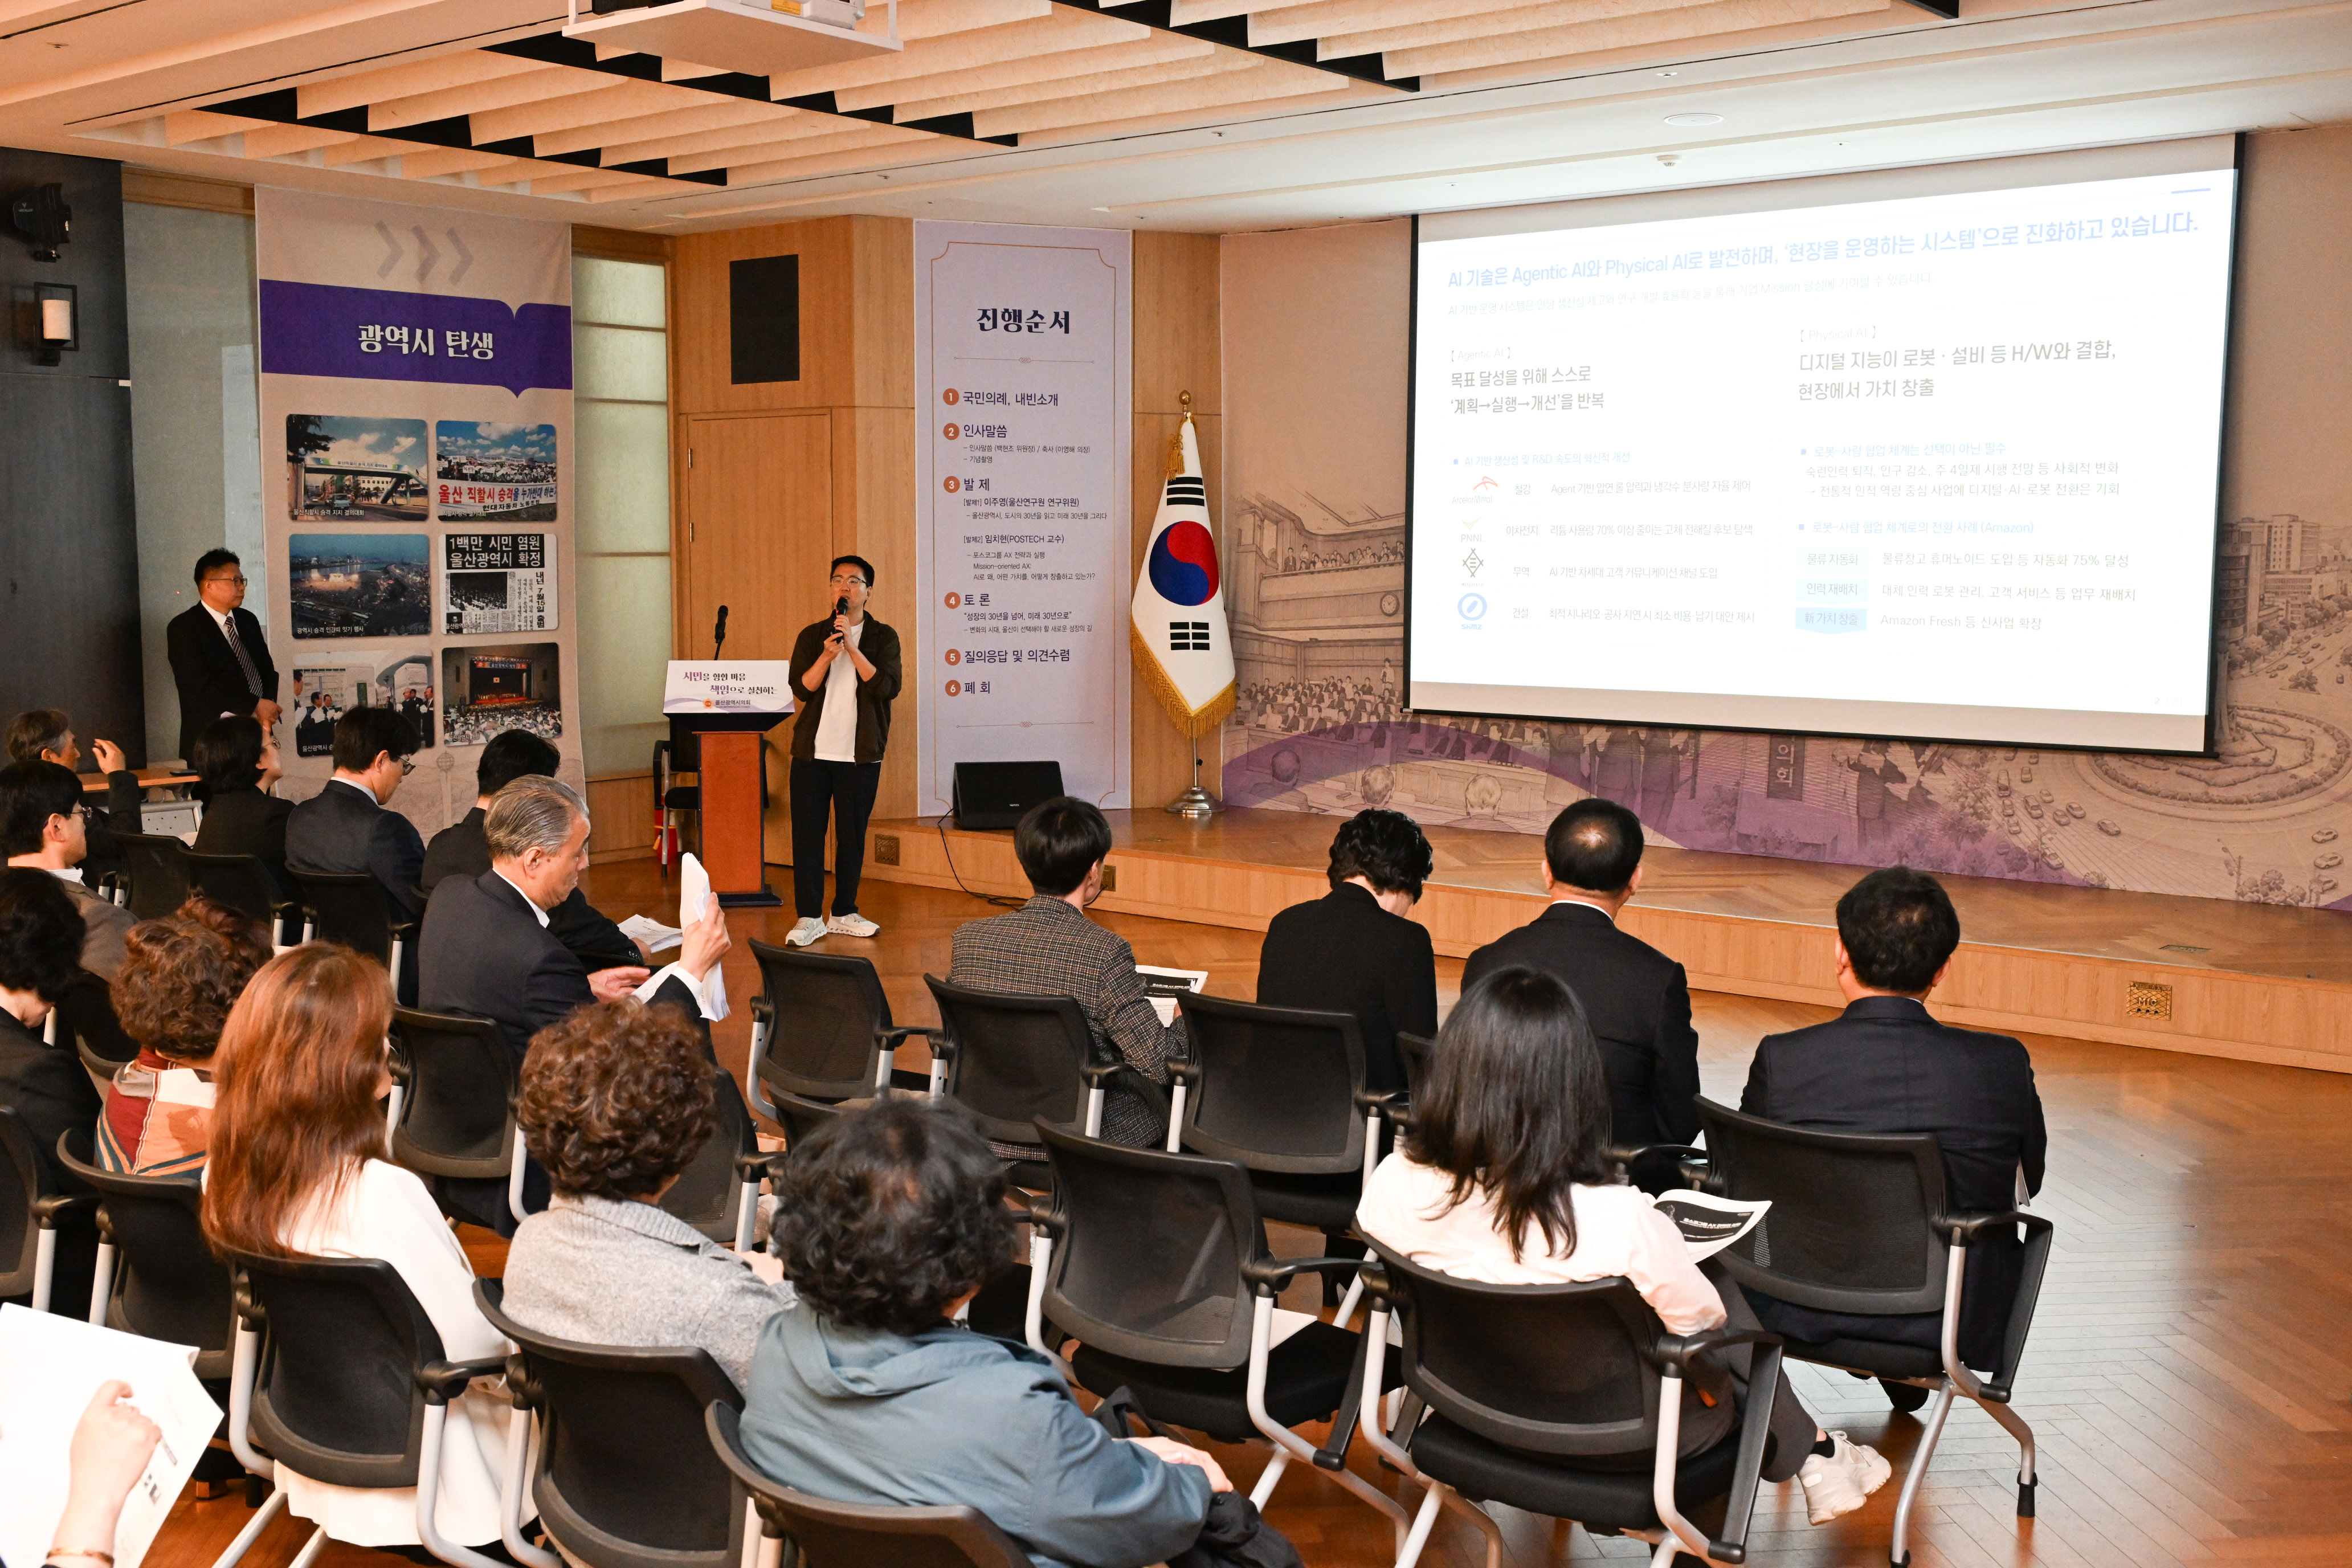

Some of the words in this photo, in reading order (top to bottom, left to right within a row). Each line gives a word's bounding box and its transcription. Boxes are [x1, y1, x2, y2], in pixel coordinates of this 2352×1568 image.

[1448, 272, 1461, 287] AI
[1467, 267, 1508, 286] 기술은
[1512, 264, 1567, 286] Agentic
[1571, 260, 1602, 277] AI와
[1606, 255, 1667, 278] Physical
[1672, 252, 1702, 270] AI로
[1709, 246, 1778, 268] 발전하며,
[1845, 235, 1914, 258] 운영하는
[2026, 219, 2102, 244] 진화하고
[2112, 212, 2198, 238] 있습니다.
[977, 308, 1069, 334] 진행순서
[358, 325, 434, 356] 광역시
[446, 331, 493, 360] 탄생
[1800, 353, 1844, 371] 디지털
[1851, 350, 1897, 369] 지능이
[1904, 349, 1935, 366] 로봇
[1952, 346, 1984, 365] 설비
[1991, 345, 2006, 363] 등
[2012, 342, 2071, 362] H/W와
[2077, 340, 2115, 360] 결합,
[1452, 372, 1475, 388] 목표
[1480, 370, 1517, 386] 달성을
[1522, 368, 1546, 384] 위해
[1552, 366, 1590, 382] 스스로
[1799, 382, 1859, 401] 현장에서
[1866, 380, 1896, 397] 가치
[1902, 378, 1934, 397] 창출
[963, 392, 1010, 406] 국민의례,
[1016, 393, 1057, 406] 내빈소개
[964, 424, 1007, 438] 인사말씀
[964, 478, 974, 491] 발
[979, 479, 989, 491] 제
[439, 484, 462, 504] 울산
[468, 487, 495, 503] 직할시
[498, 488, 519, 504] 승격을
[521, 487, 543, 501] 누가반대
[985, 497, 1044, 507] 이주영(울산연구원
[1048, 498, 1079, 507] 연구위원)
[450, 536, 483, 550] 1백만
[489, 536, 512, 550] 시민
[518, 536, 540, 550] 염원
[985, 535, 1044, 544] 임치현(POSTECH
[1047, 534, 1064, 543] 교수)
[450, 552, 513, 569] 울산광역시
[518, 552, 540, 566] 확정
[1807, 554, 1826, 565] 물류
[1830, 554, 1858, 565] 자동화
[1883, 553, 1925, 565] 물류창고
[1930, 553, 1985, 565] 휴머노이드
[1991, 554, 2012, 565] 도입
[2018, 554, 2028, 566] 등
[2034, 554, 2068, 566] 자동화
[2073, 555, 2099, 565] 75%
[2105, 555, 2128, 567] 달성
[536, 571, 544, 585] 내년
[1807, 583, 1825, 595] 인력
[1828, 584, 1857, 595] 재배치
[1883, 585, 1902, 597] 대체
[1908, 585, 1928, 597] 인력
[1933, 586, 1954, 597] 로봇
[1959, 586, 1983, 598] 관리,
[1989, 587, 2011, 599] 고객
[2016, 587, 2049, 599] 서비스
[2056, 588, 2065, 599] 등
[2072, 588, 2094, 601] 업무
[2100, 589, 2135, 601] 재배치
[964, 595, 974, 605] 토
[979, 594, 990, 606] 론
[1881, 615, 1925, 625] Amazon
[1930, 616, 1961, 626] Fresh
[1966, 616, 1975, 628] 등
[1981, 617, 2014, 629] 신사업
[2019, 618, 2041, 630] 확장
[965, 650, 1008, 663] 질의응답
[1013, 650, 1022, 662] 및
[1028, 649, 1069, 662] 의견수렴
[684, 672, 709, 681] 시민을
[710, 685, 744, 695] 책임으로
[965, 681, 975, 694] 폐
[980, 681, 990, 693] 회
